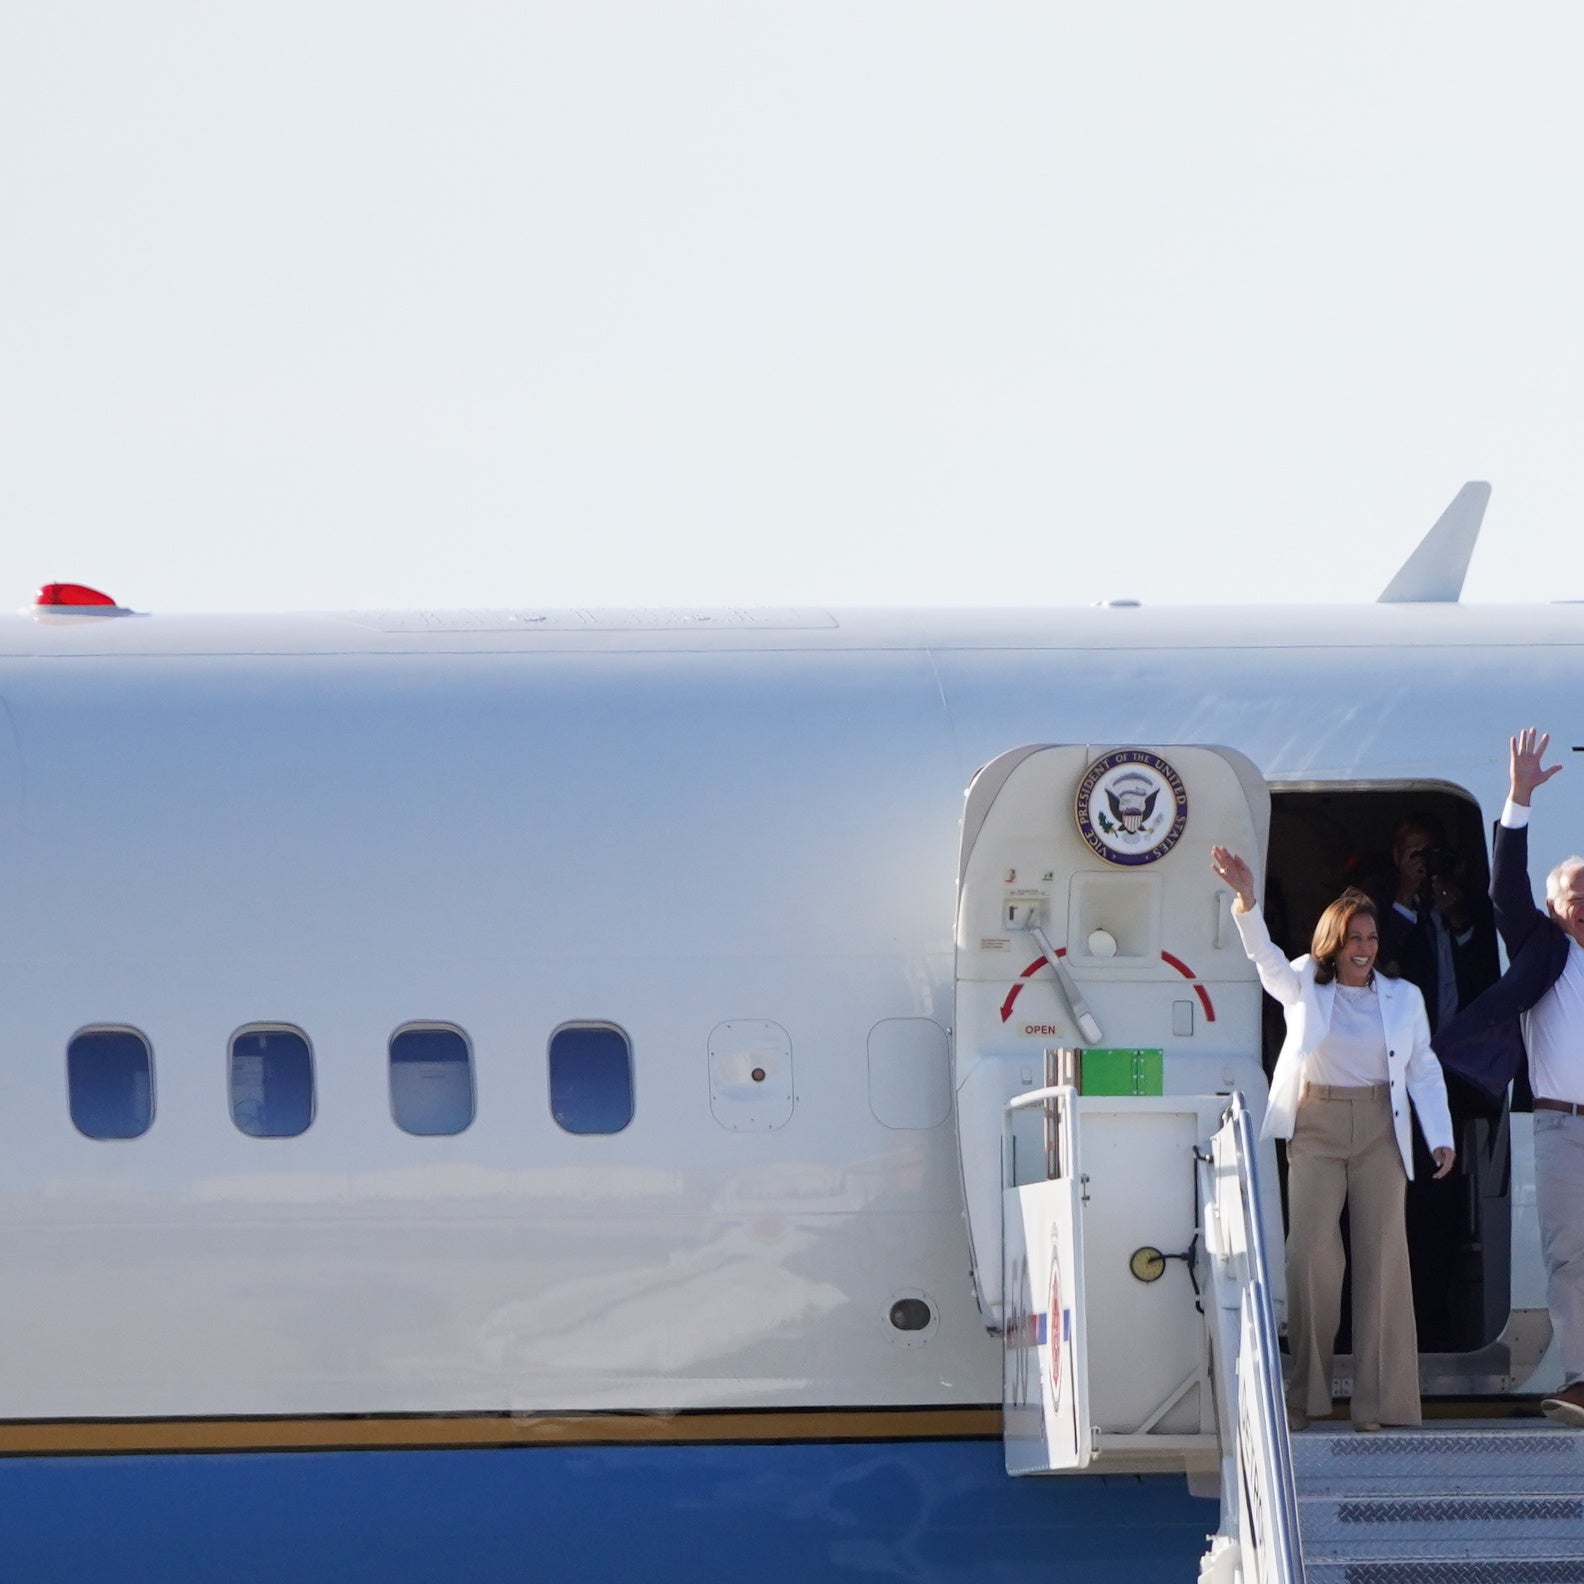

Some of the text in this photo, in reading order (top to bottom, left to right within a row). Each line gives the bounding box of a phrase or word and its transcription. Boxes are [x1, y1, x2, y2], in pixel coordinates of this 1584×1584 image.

[1078, 752, 1186, 858] VICE PRESIDENT OF THE UNITED STATES
[1025, 1025, 1056, 1035] OPEN
